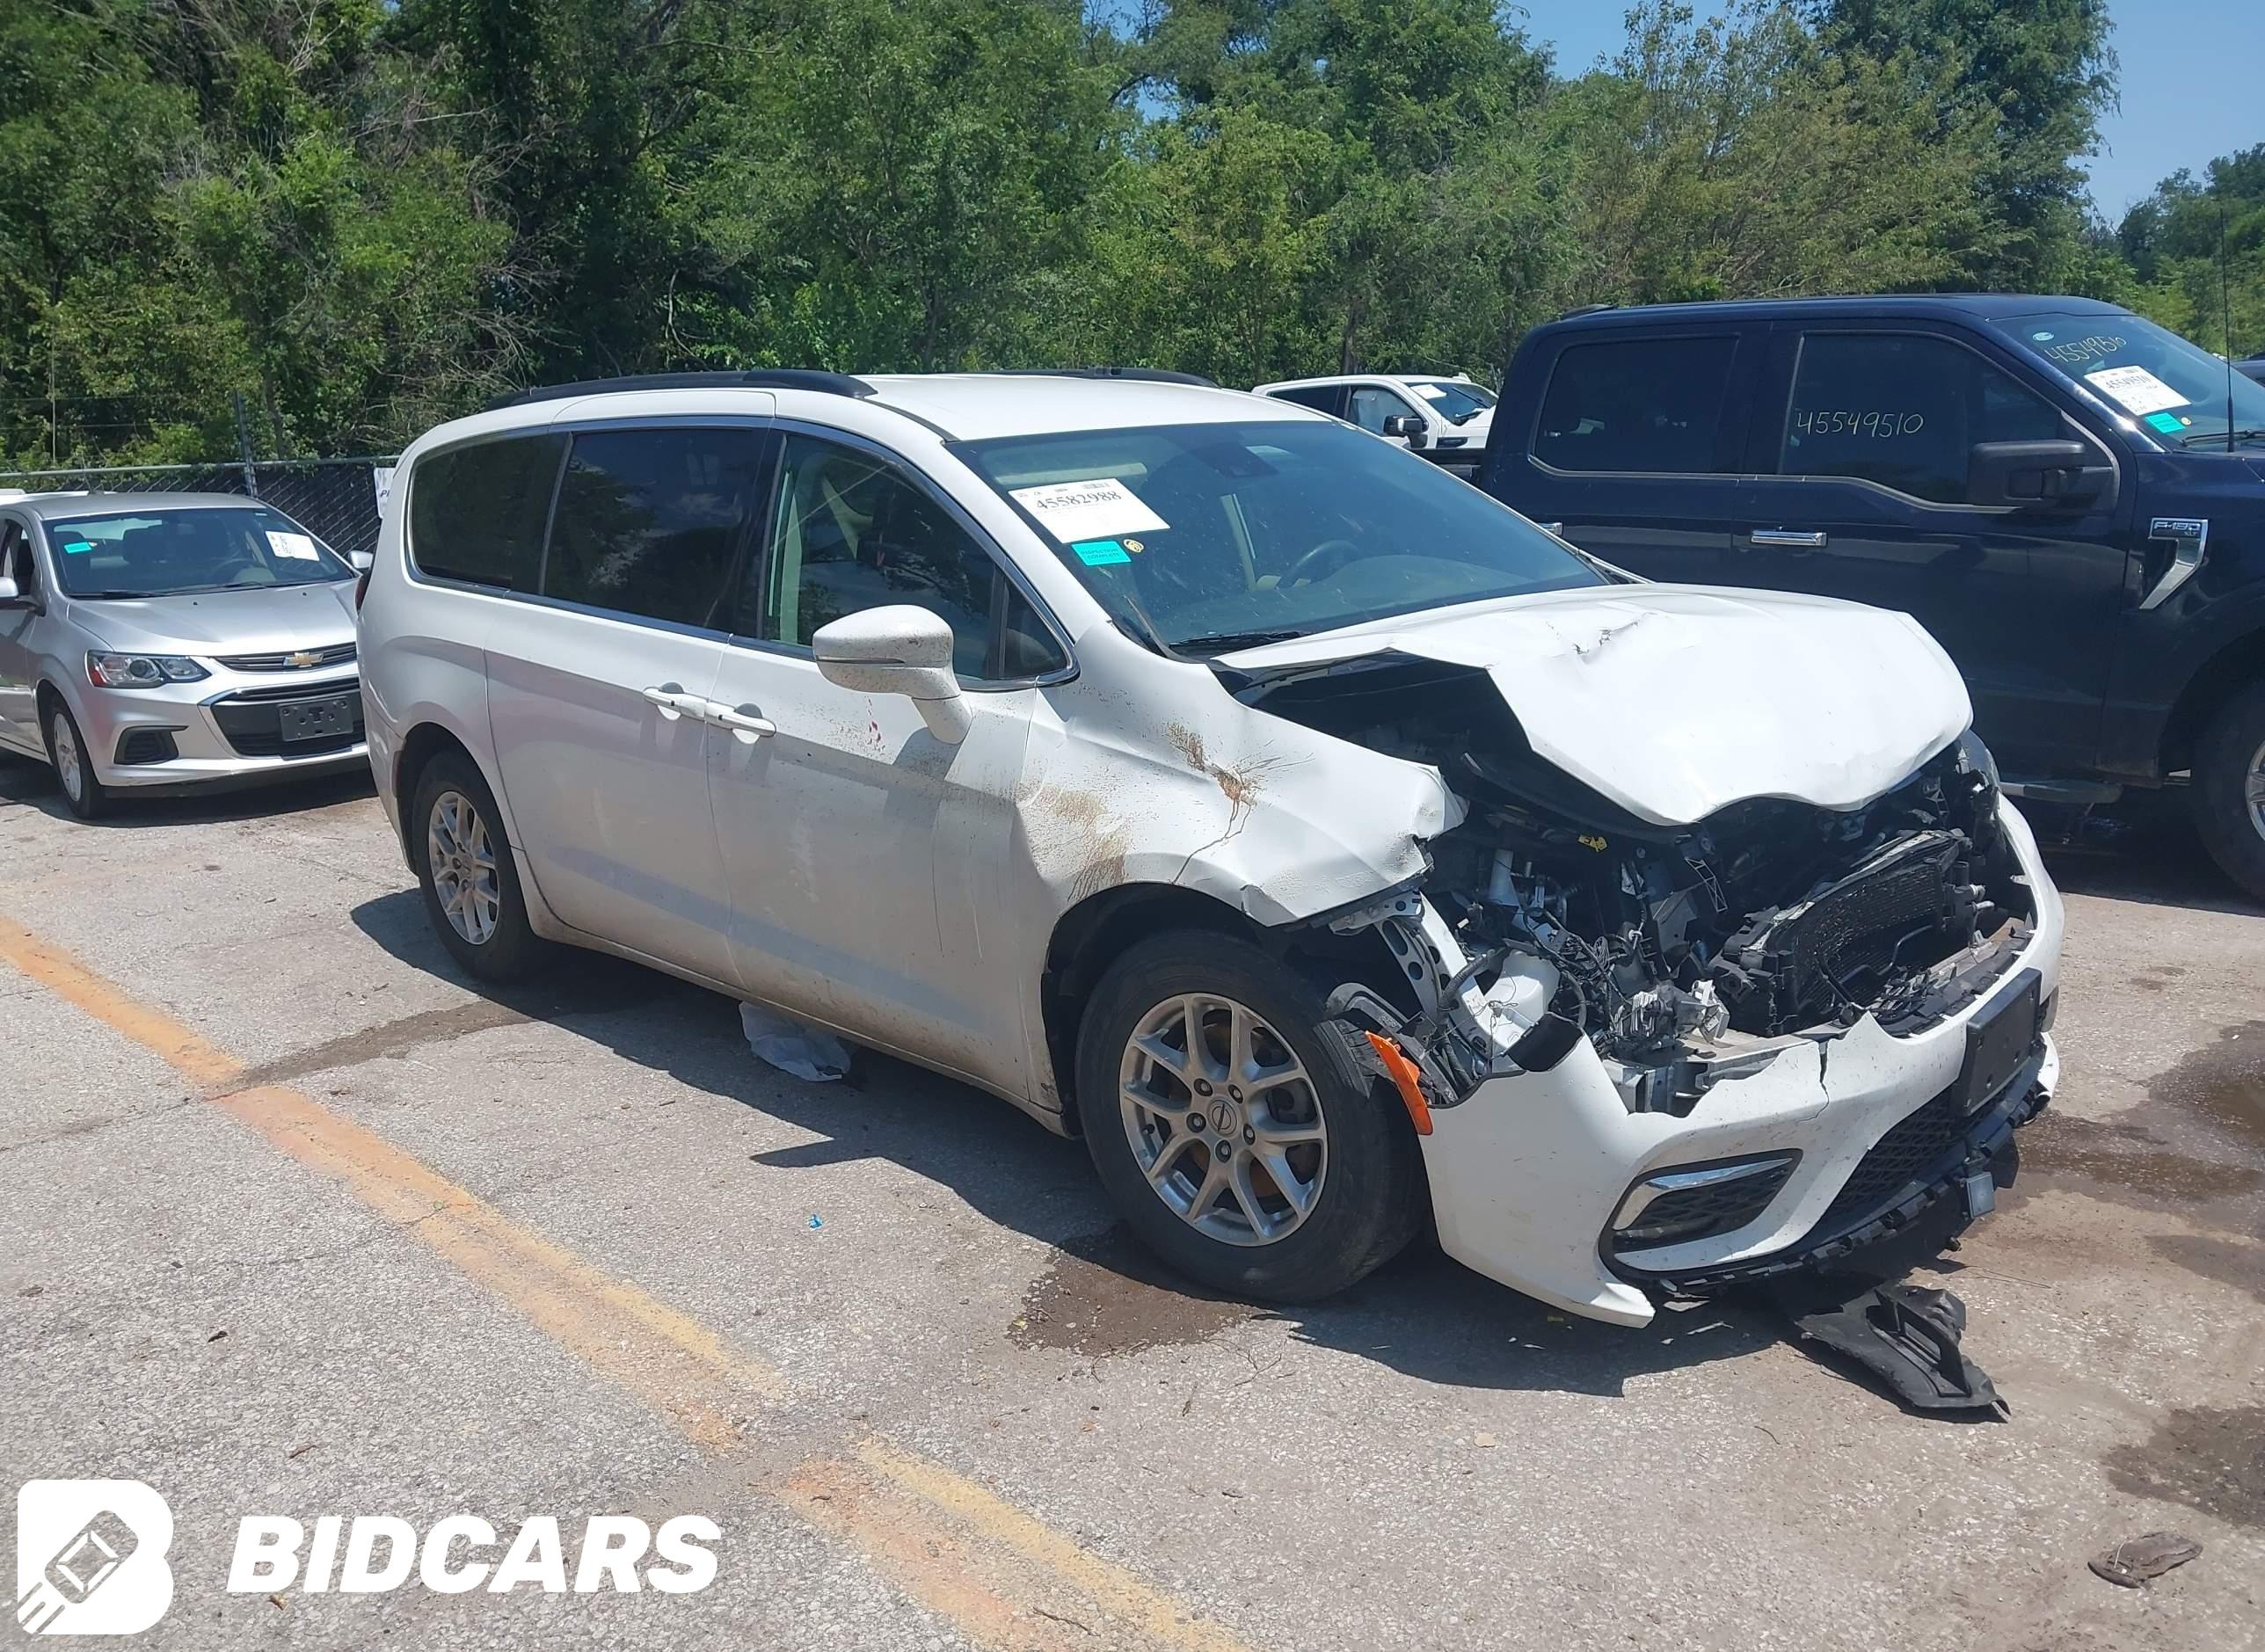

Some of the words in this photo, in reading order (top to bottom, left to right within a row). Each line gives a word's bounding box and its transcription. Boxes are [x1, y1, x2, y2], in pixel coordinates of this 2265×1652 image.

[2044, 336, 2127, 362] 45549510
[1797, 411, 1924, 437] 45549510
[1037, 491, 1122, 509] 45582988
[2154, 521, 2201, 531] F-150
